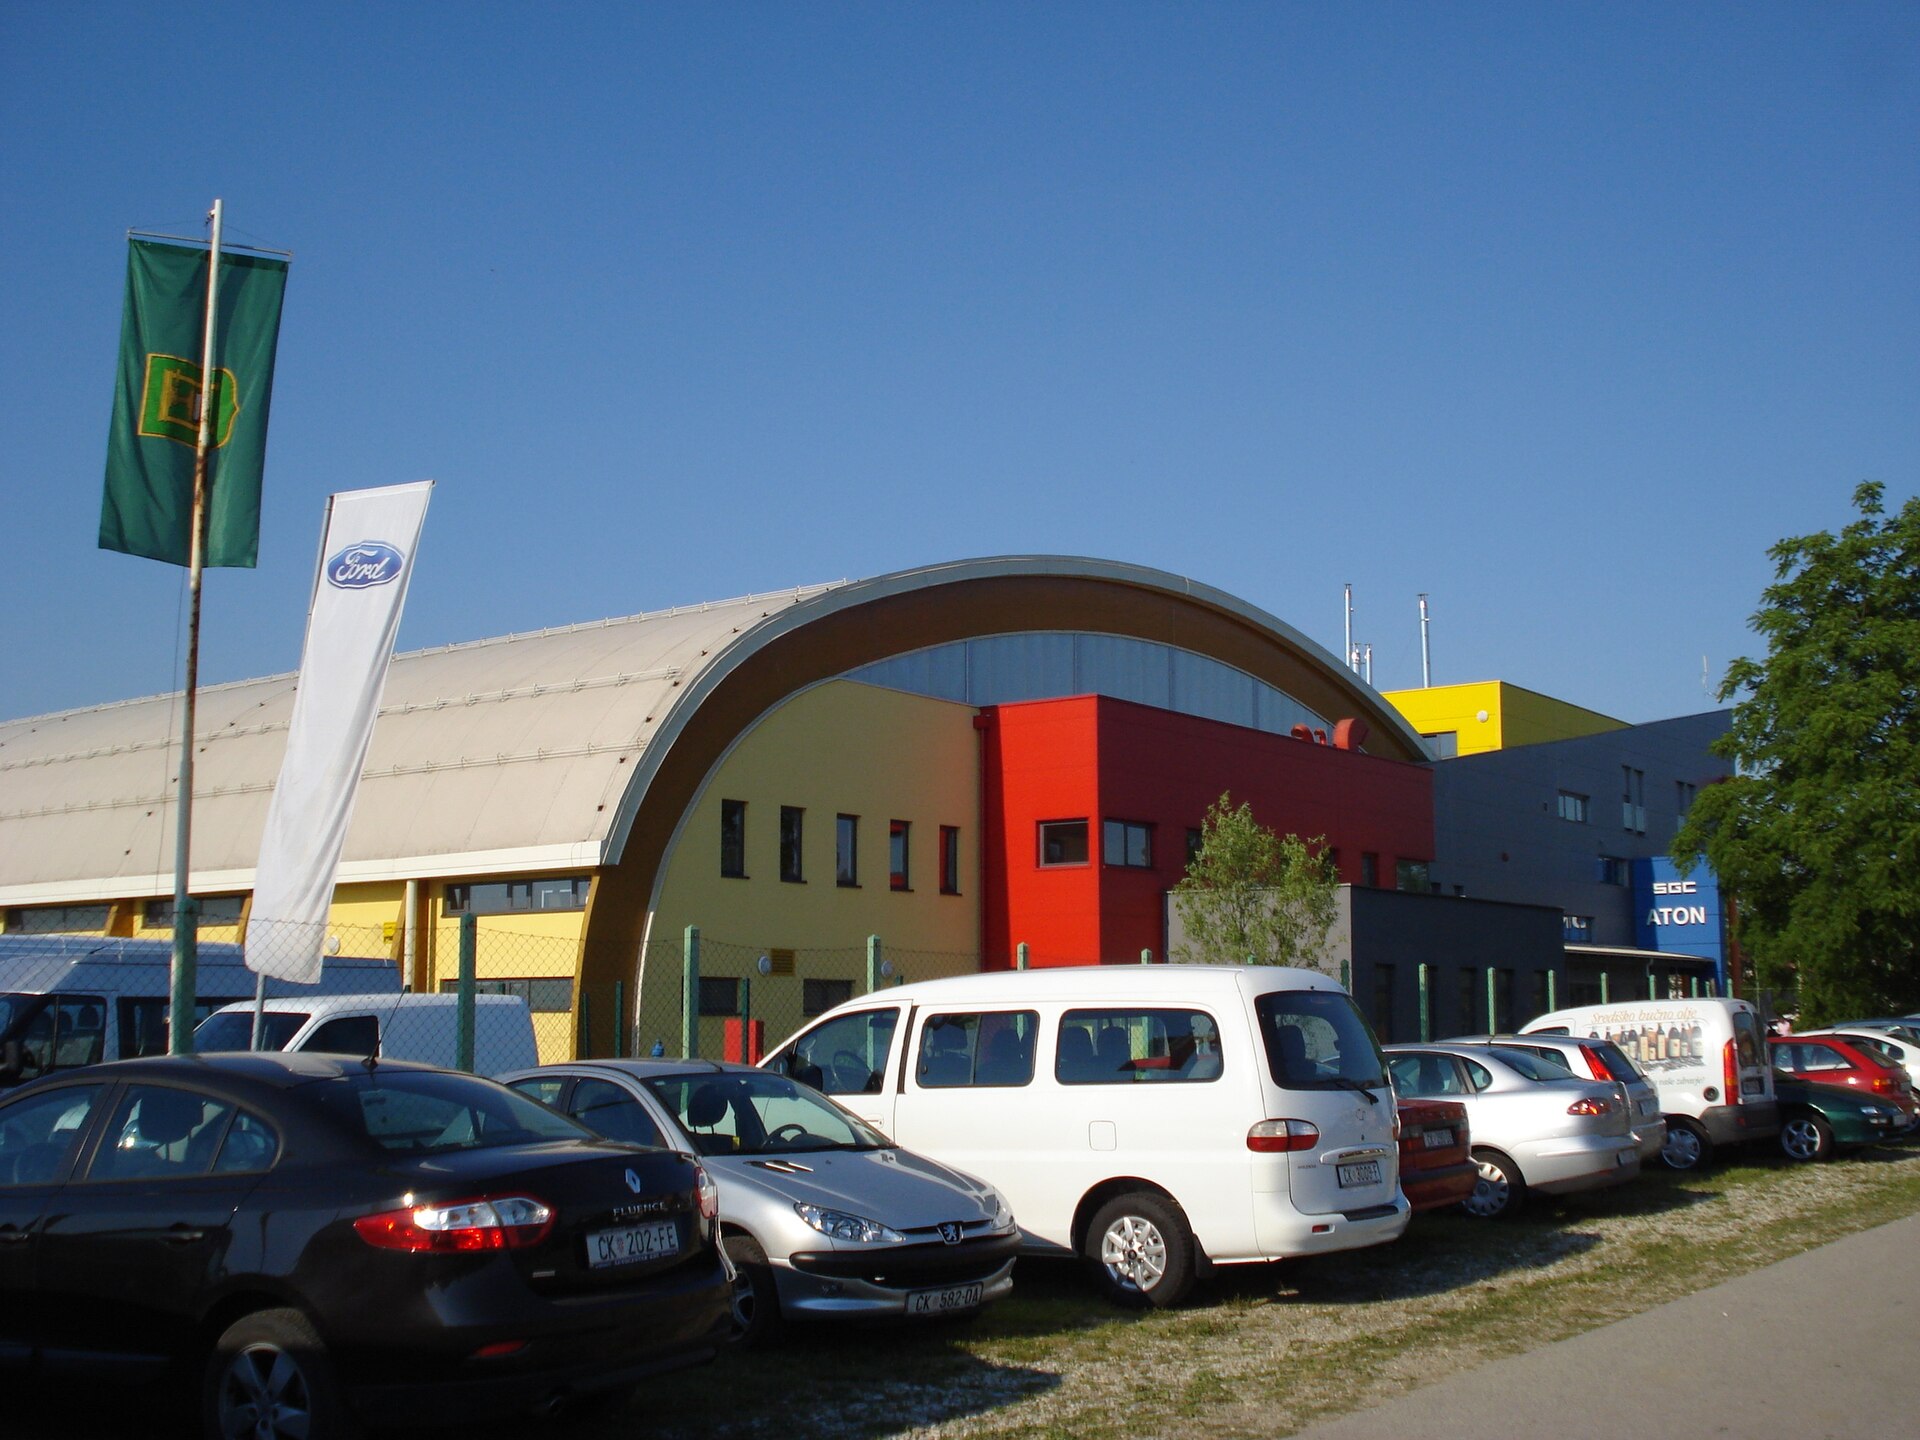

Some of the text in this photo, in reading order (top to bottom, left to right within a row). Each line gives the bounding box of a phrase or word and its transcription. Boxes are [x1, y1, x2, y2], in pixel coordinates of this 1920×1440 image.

[336, 549, 390, 581] Ford
[1653, 881, 1697, 895] SGC
[1646, 906, 1706, 926] ATON
[613, 1201, 666, 1217] FLUENCE
[598, 1234, 616, 1260] CK
[626, 1225, 676, 1256] 202-FE
[916, 1294, 931, 1312] CK
